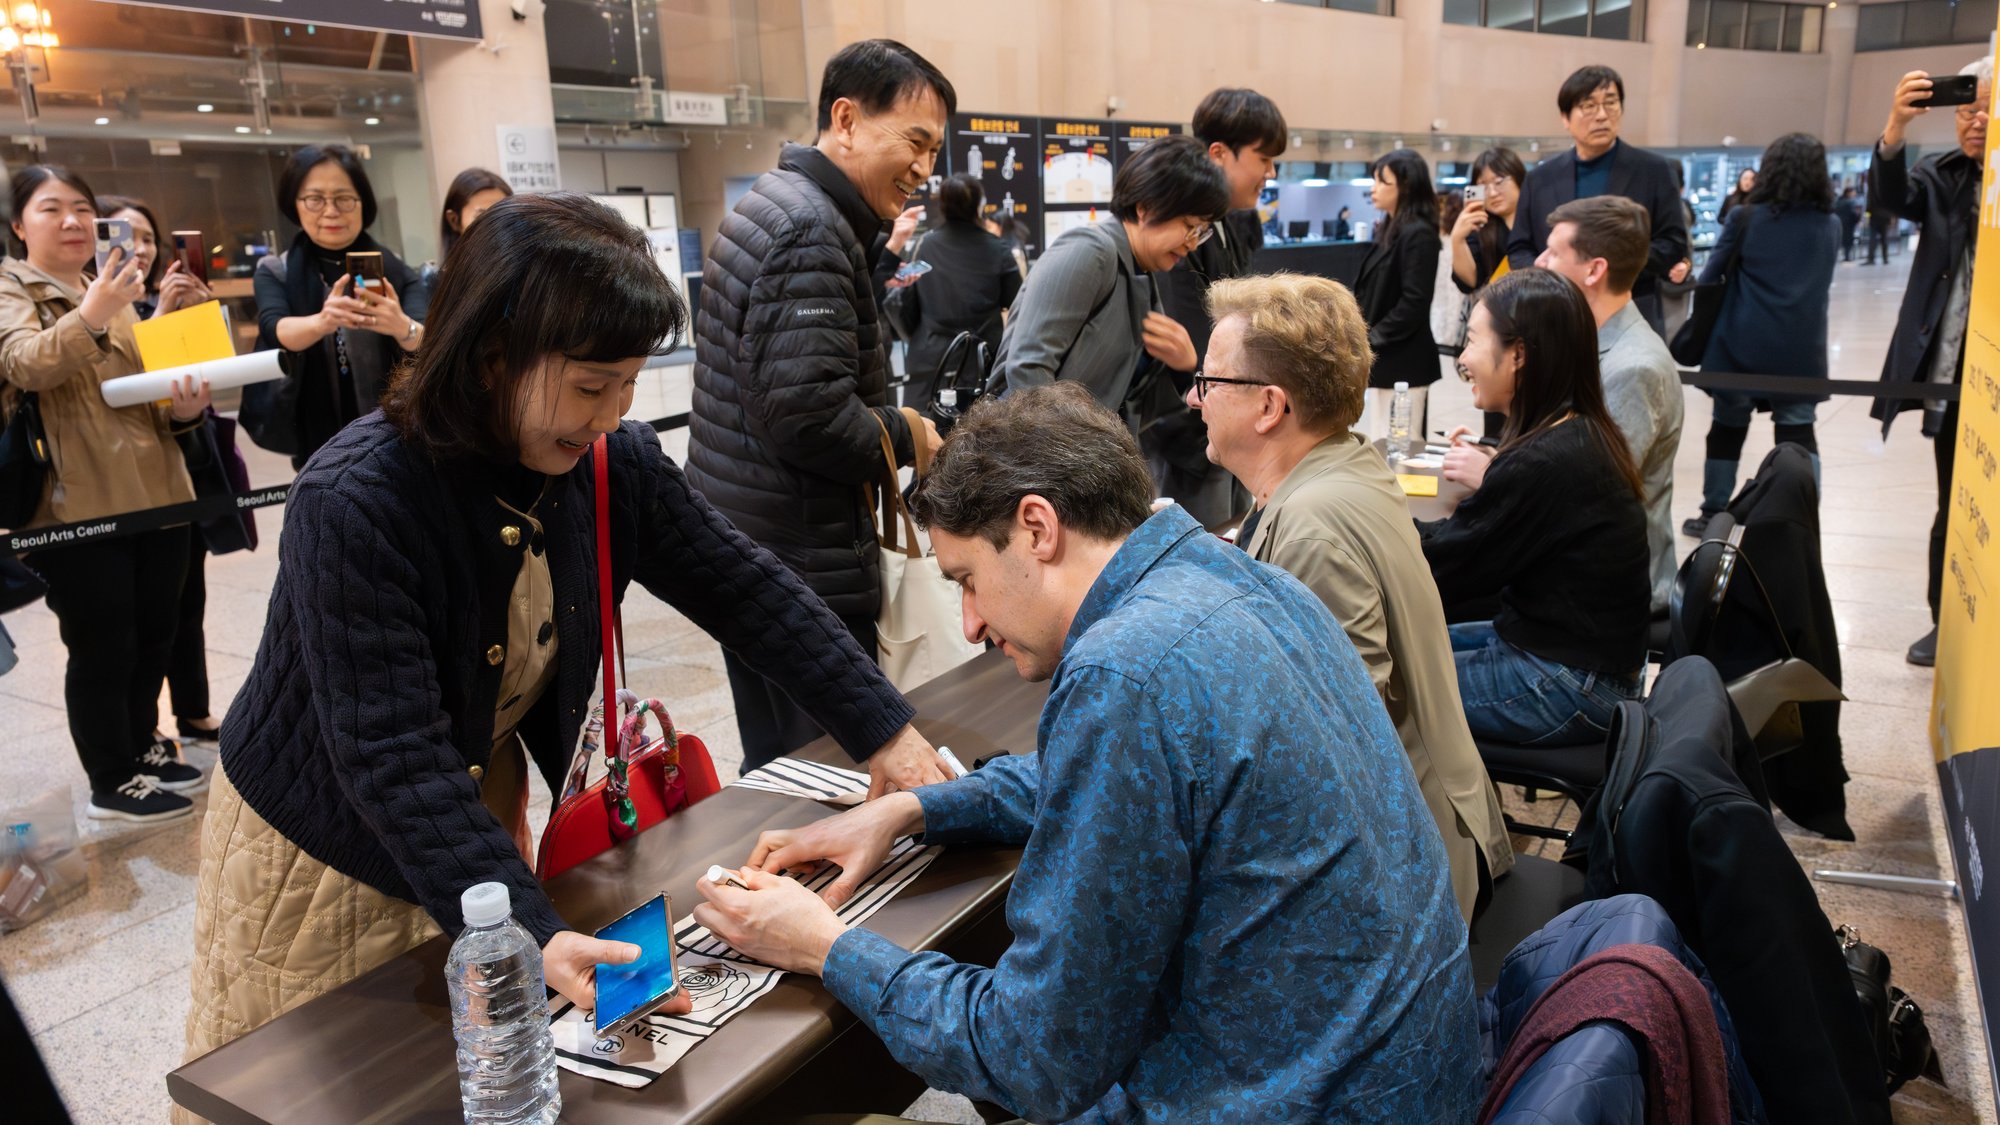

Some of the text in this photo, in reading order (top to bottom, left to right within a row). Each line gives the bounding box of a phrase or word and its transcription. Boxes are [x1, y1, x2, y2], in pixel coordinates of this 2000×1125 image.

[797, 308, 835, 316] GALDERMA
[236, 490, 287, 508] Seoul Arts
[11, 521, 118, 550] Seoul Arts Center
[584, 1011, 669, 1046] CNEL
